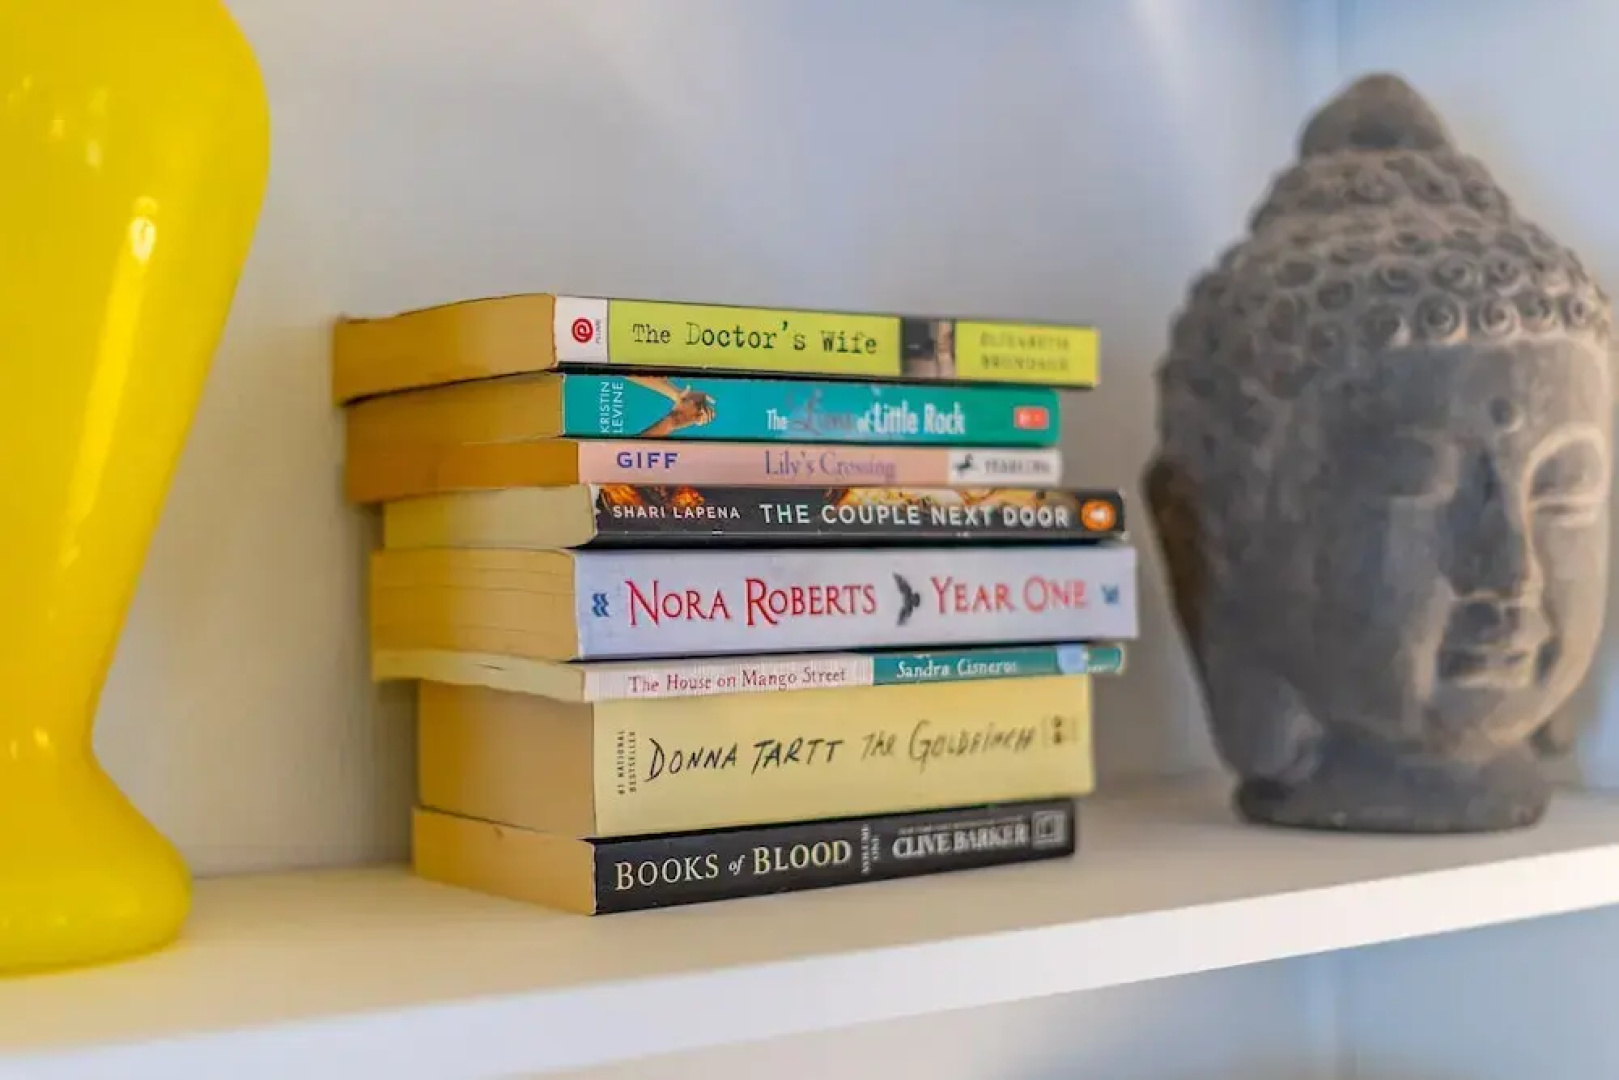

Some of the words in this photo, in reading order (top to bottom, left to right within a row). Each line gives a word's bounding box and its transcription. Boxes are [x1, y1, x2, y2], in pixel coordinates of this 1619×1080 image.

[632, 323, 671, 344] The
[685, 321, 806, 351] Doctor's
[820, 329, 877, 355] Wife
[600, 381, 610, 434] KRISTIN
[612, 382, 624, 434] LEVINE
[766, 408, 788, 431] The
[873, 400, 918, 434] Little
[924, 401, 965, 434] Rock
[616, 451, 680, 469] GIFF
[765, 450, 815, 477] Lily's
[819, 451, 896, 482] Crossing
[613, 505, 665, 519] SHARI
[673, 505, 741, 519] LAPENA
[759, 504, 810, 524] THE
[821, 504, 921, 525] COUPLE
[931, 506, 993, 526] NEXT
[1003, 506, 1069, 527] DOOR
[625, 577, 731, 626] NORA
[745, 576, 877, 626] ROBERTS
[931, 575, 1015, 614] YEAR
[1023, 575, 1088, 613] ONE
[628, 675, 659, 692] The
[667, 672, 711, 690] House
[717, 673, 736, 687] on
[742, 668, 797, 690] Mango
[802, 666, 846, 684] Street
[897, 657, 950, 679] Sandra
[957, 658, 1018, 676] Cisneros
[616, 730, 625, 778] NATIONAL
[644, 737, 738, 782] DONNA
[751, 736, 844, 775] TARTT
[892, 832, 951, 859] CLIVE
[953, 822, 1030, 853] BARKER
[615, 854, 720, 891] BOOKS
[728, 855, 746, 876] of
[752, 840, 852, 875] BLOOD
